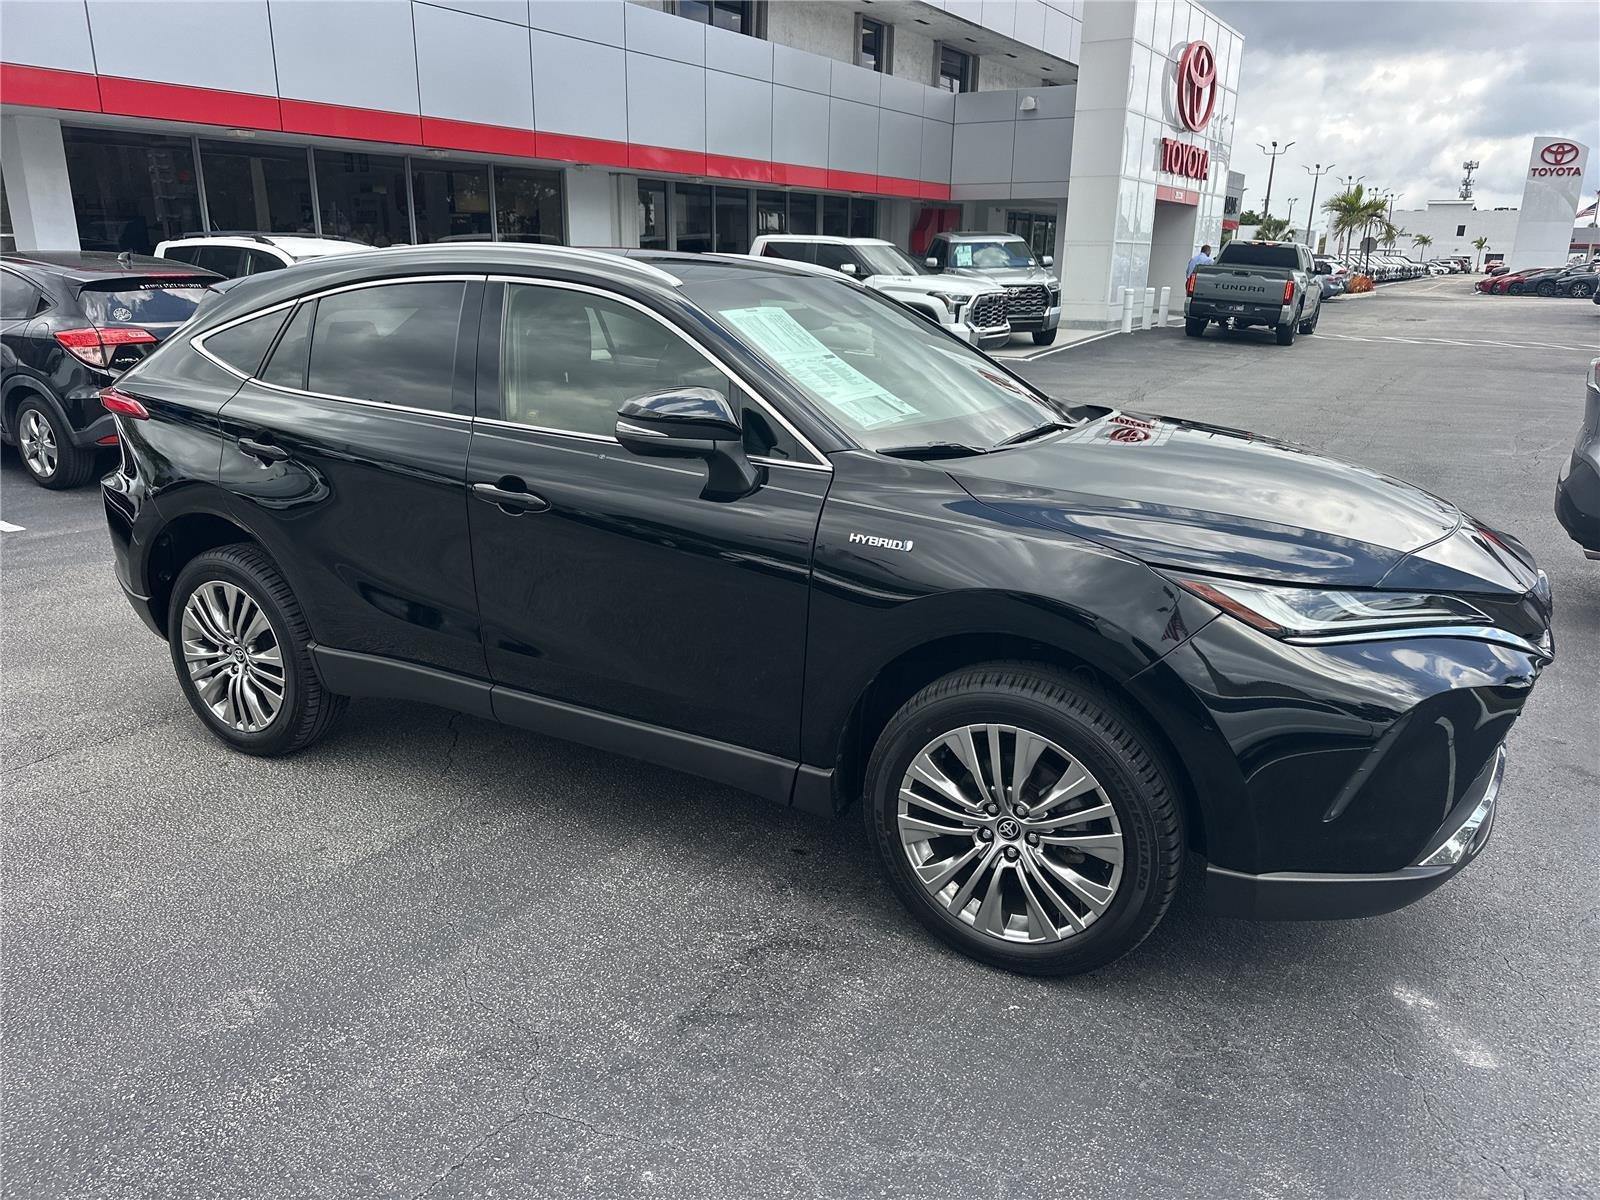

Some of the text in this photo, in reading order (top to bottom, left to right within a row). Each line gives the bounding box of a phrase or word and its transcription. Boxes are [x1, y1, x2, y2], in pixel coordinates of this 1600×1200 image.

[1162, 138, 1209, 181] TOYOTA
[1531, 167, 1582, 177] TOYOTA
[1214, 283, 1265, 293] TUNDRA
[849, 533, 903, 550] HYBRID
